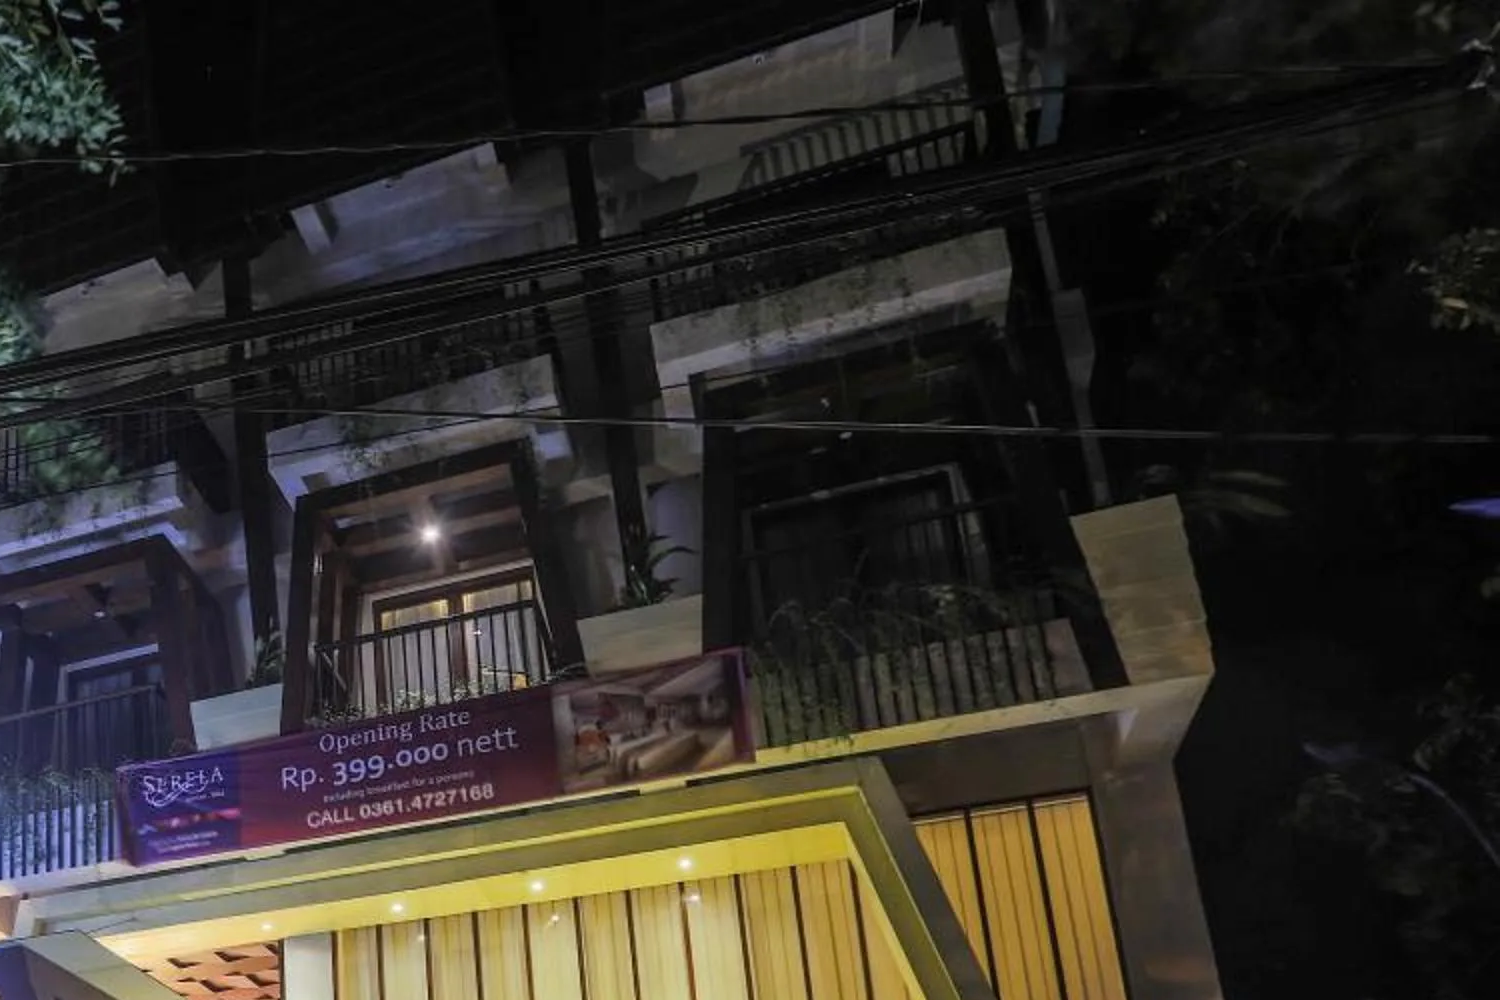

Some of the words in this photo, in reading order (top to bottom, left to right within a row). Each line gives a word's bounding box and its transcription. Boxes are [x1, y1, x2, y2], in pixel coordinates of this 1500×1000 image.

[319, 721, 413, 755] Opening
[419, 711, 470, 733] Rate
[281, 766, 325, 793] Rp.
[332, 742, 449, 786] 399.000
[457, 727, 520, 757] nett
[307, 805, 355, 828] CALL
[359, 782, 495, 819] 0361.4727168
